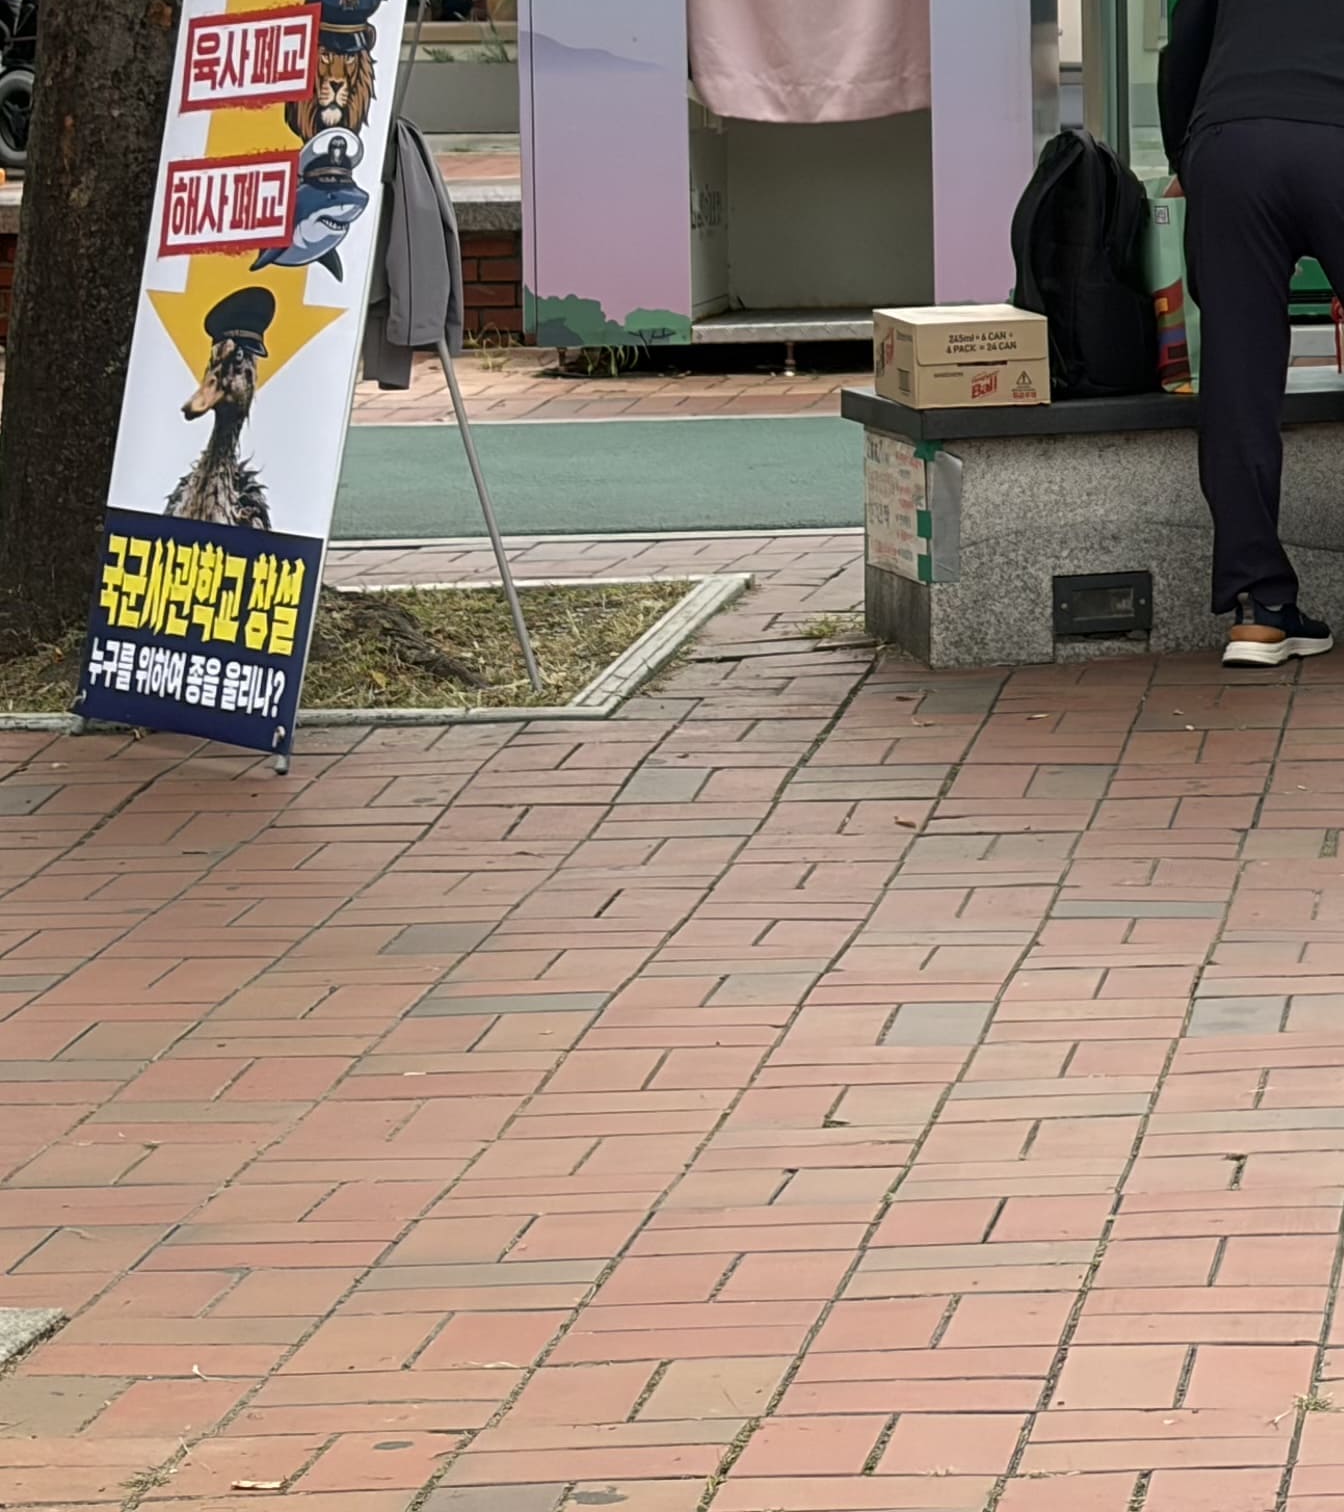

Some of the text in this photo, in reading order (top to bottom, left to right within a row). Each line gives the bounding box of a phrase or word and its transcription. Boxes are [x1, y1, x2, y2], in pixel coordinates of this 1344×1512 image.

[193, 23, 308, 90] 육사 폐교
[171, 170, 286, 236] 해사 폐교
[953, 344, 976, 354] PACK
[998, 341, 1017, 350] CAN
[987, 331, 1007, 341] CAN
[100, 533, 305, 656] 국군사관학교 창설
[88, 637, 286, 718] 누구를 위하여 종을 울리나?
